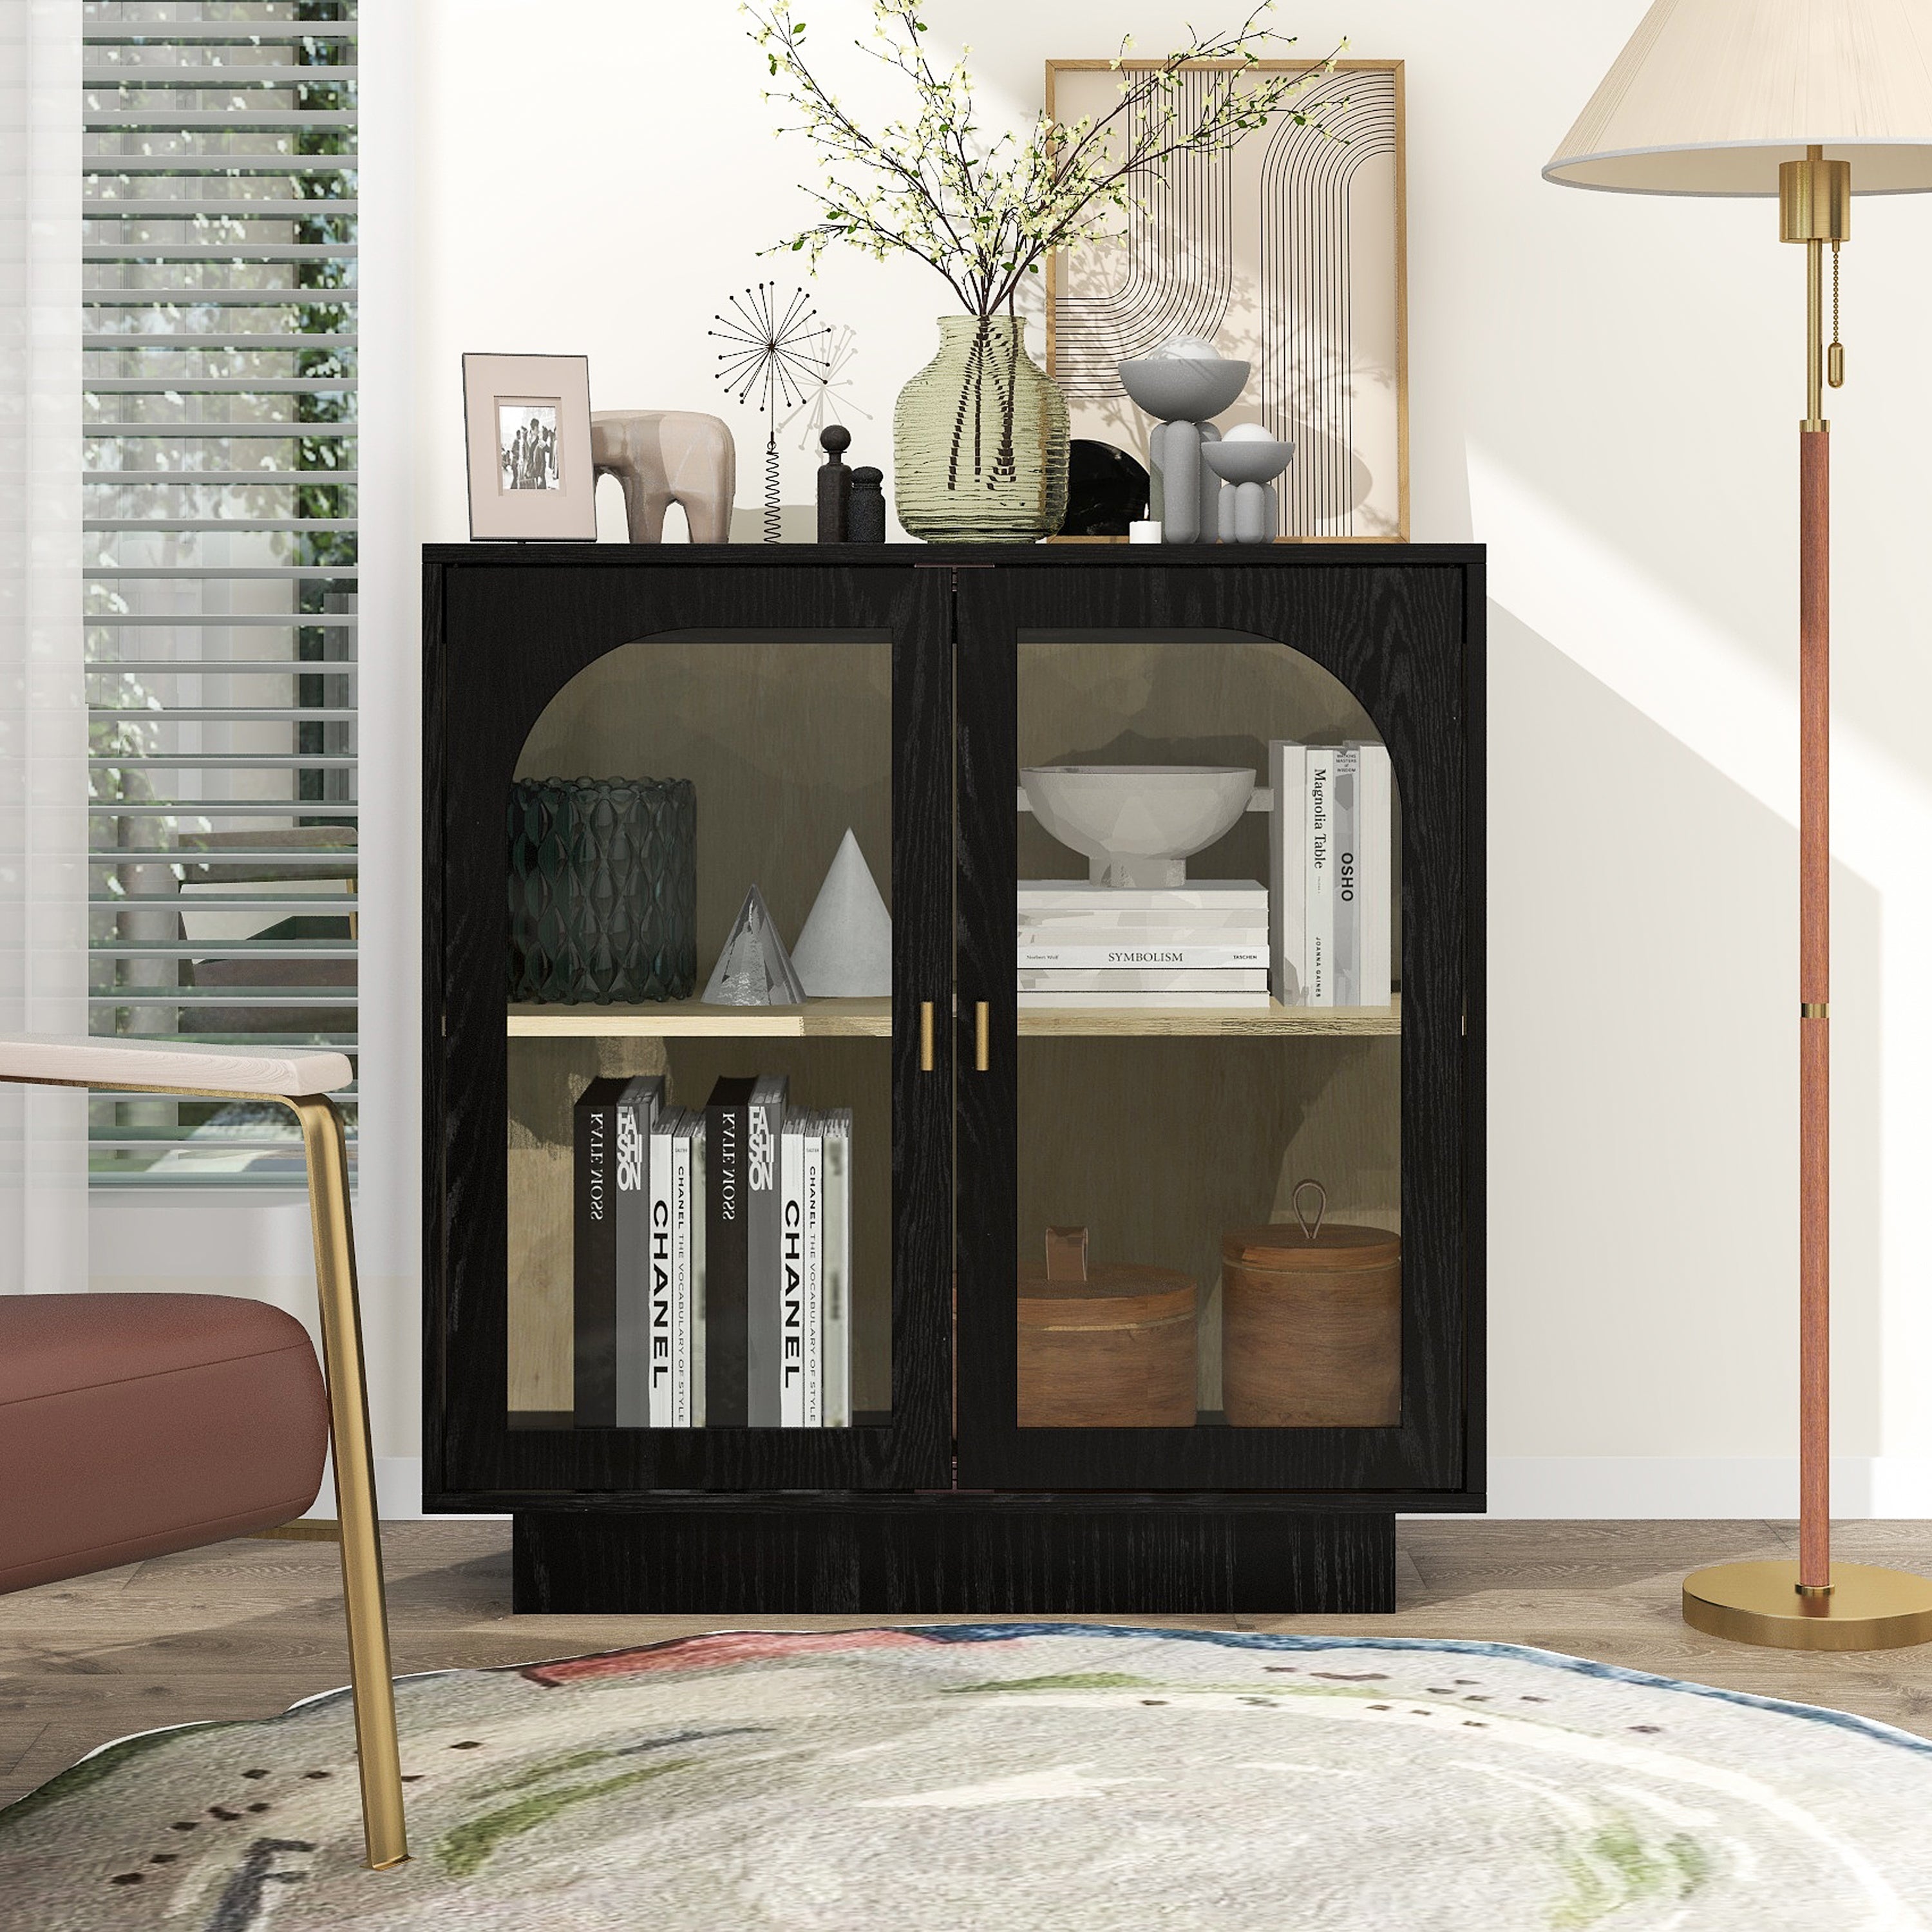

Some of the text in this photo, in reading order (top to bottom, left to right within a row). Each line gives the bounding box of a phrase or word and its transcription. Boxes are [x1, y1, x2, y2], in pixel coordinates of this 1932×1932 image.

[1312, 769, 1327, 869] Magnolia Table
[1341, 852, 1354, 902] OSHO
[1108, 952, 1184, 962] SYMBOLISM
[653, 1200, 668, 1388] CHANEL
[784, 1200, 800, 1388] CHANEL
[678, 1359, 684, 1377] OF
[810, 1359, 815, 1377] OF
